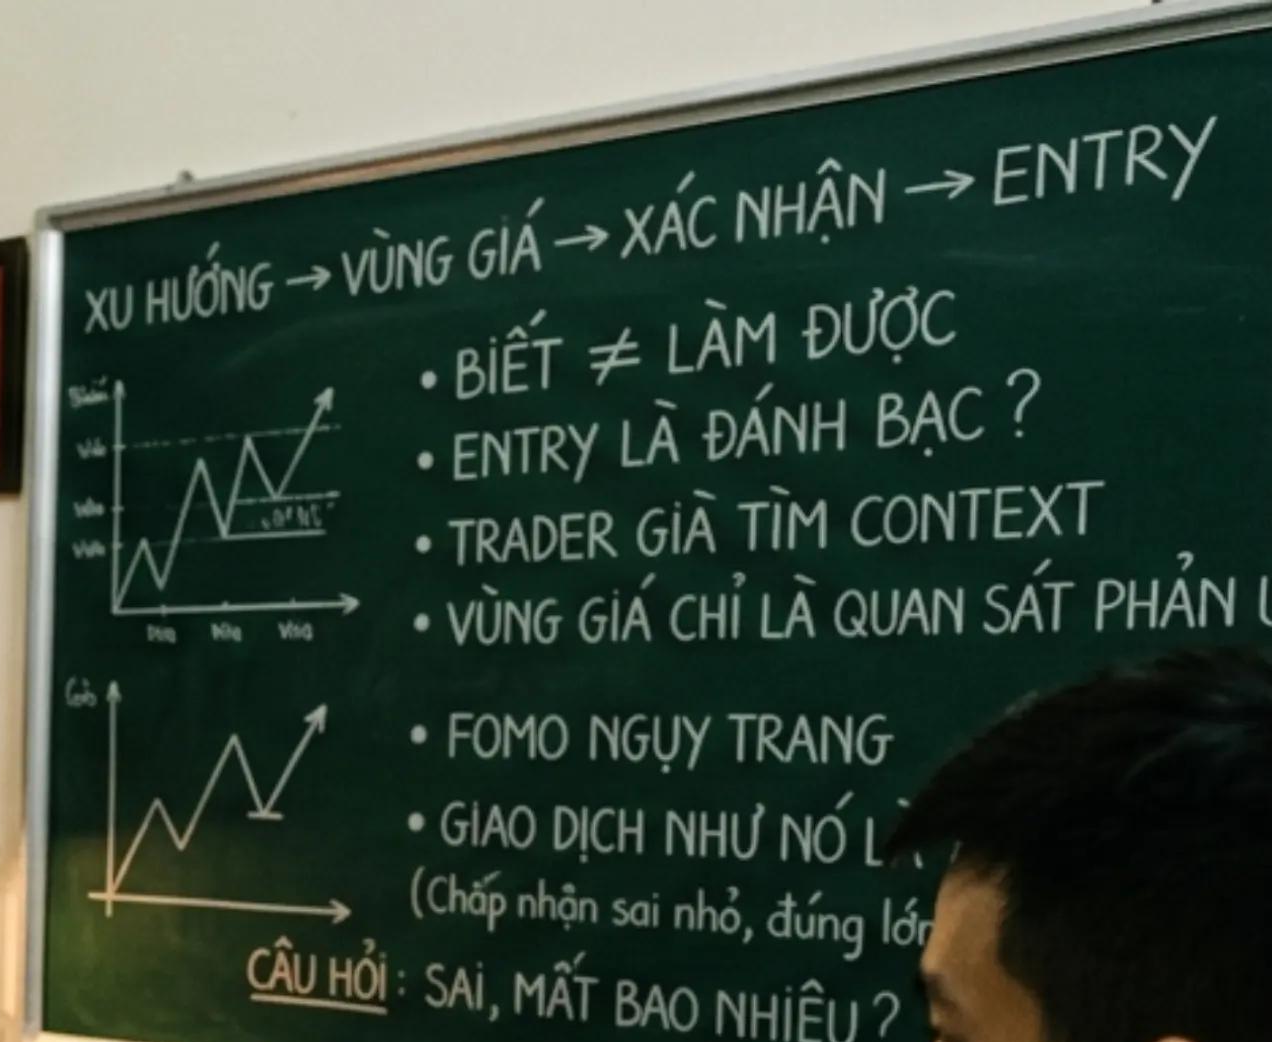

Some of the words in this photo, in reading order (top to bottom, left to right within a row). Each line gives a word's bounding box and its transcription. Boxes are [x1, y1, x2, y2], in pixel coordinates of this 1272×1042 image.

[86, 285, 133, 332] XU
[146, 242, 274, 324] HƯỚNG
[342, 228, 453, 295] VÙNG
[621, 171, 716, 258] XÁC
[736, 158, 885, 243] NHẬN
[994, 116, 1217, 205] ENTRY
[668, 299, 775, 374] LÀM
[802, 286, 955, 363] ĐƯỢC
[454, 423, 599, 482] ENTRY
[621, 399, 679, 467] LÀ
[702, 383, 846, 461] ĐÁNH
[877, 386, 984, 456] BẠC
[448, 511, 618, 565] TRADER
[738, 486, 827, 551] TÌM
[851, 481, 1105, 546] CONTEXT
[447, 584, 562, 645] VÙNG
[670, 572, 745, 641] CHỈ
[761, 574, 816, 639] LÀ
[834, 588, 964, 637] QUAN
[983, 558, 1075, 634] SÁT
[1096, 551, 1235, 631] PHẢN
[449, 713, 568, 760] FOMO
[590, 714, 711, 773] NGỤY
[728, 714, 894, 765] TRANG
[554, 806, 644, 863] DỊCH
[666, 803, 765, 860] NHƯ
[780, 792, 853, 863] NÓ
[865, 798, 923, 869] L
[411, 866, 507, 932] (Chấp
[612, 893, 659, 927] sai
[674, 886, 753, 943] nhỏ,
[767, 891, 864, 961] đúng
[247, 936, 316, 993] CÂU
[514, 952, 598, 1021] MẤT
[616, 980, 699, 1032] BAO
